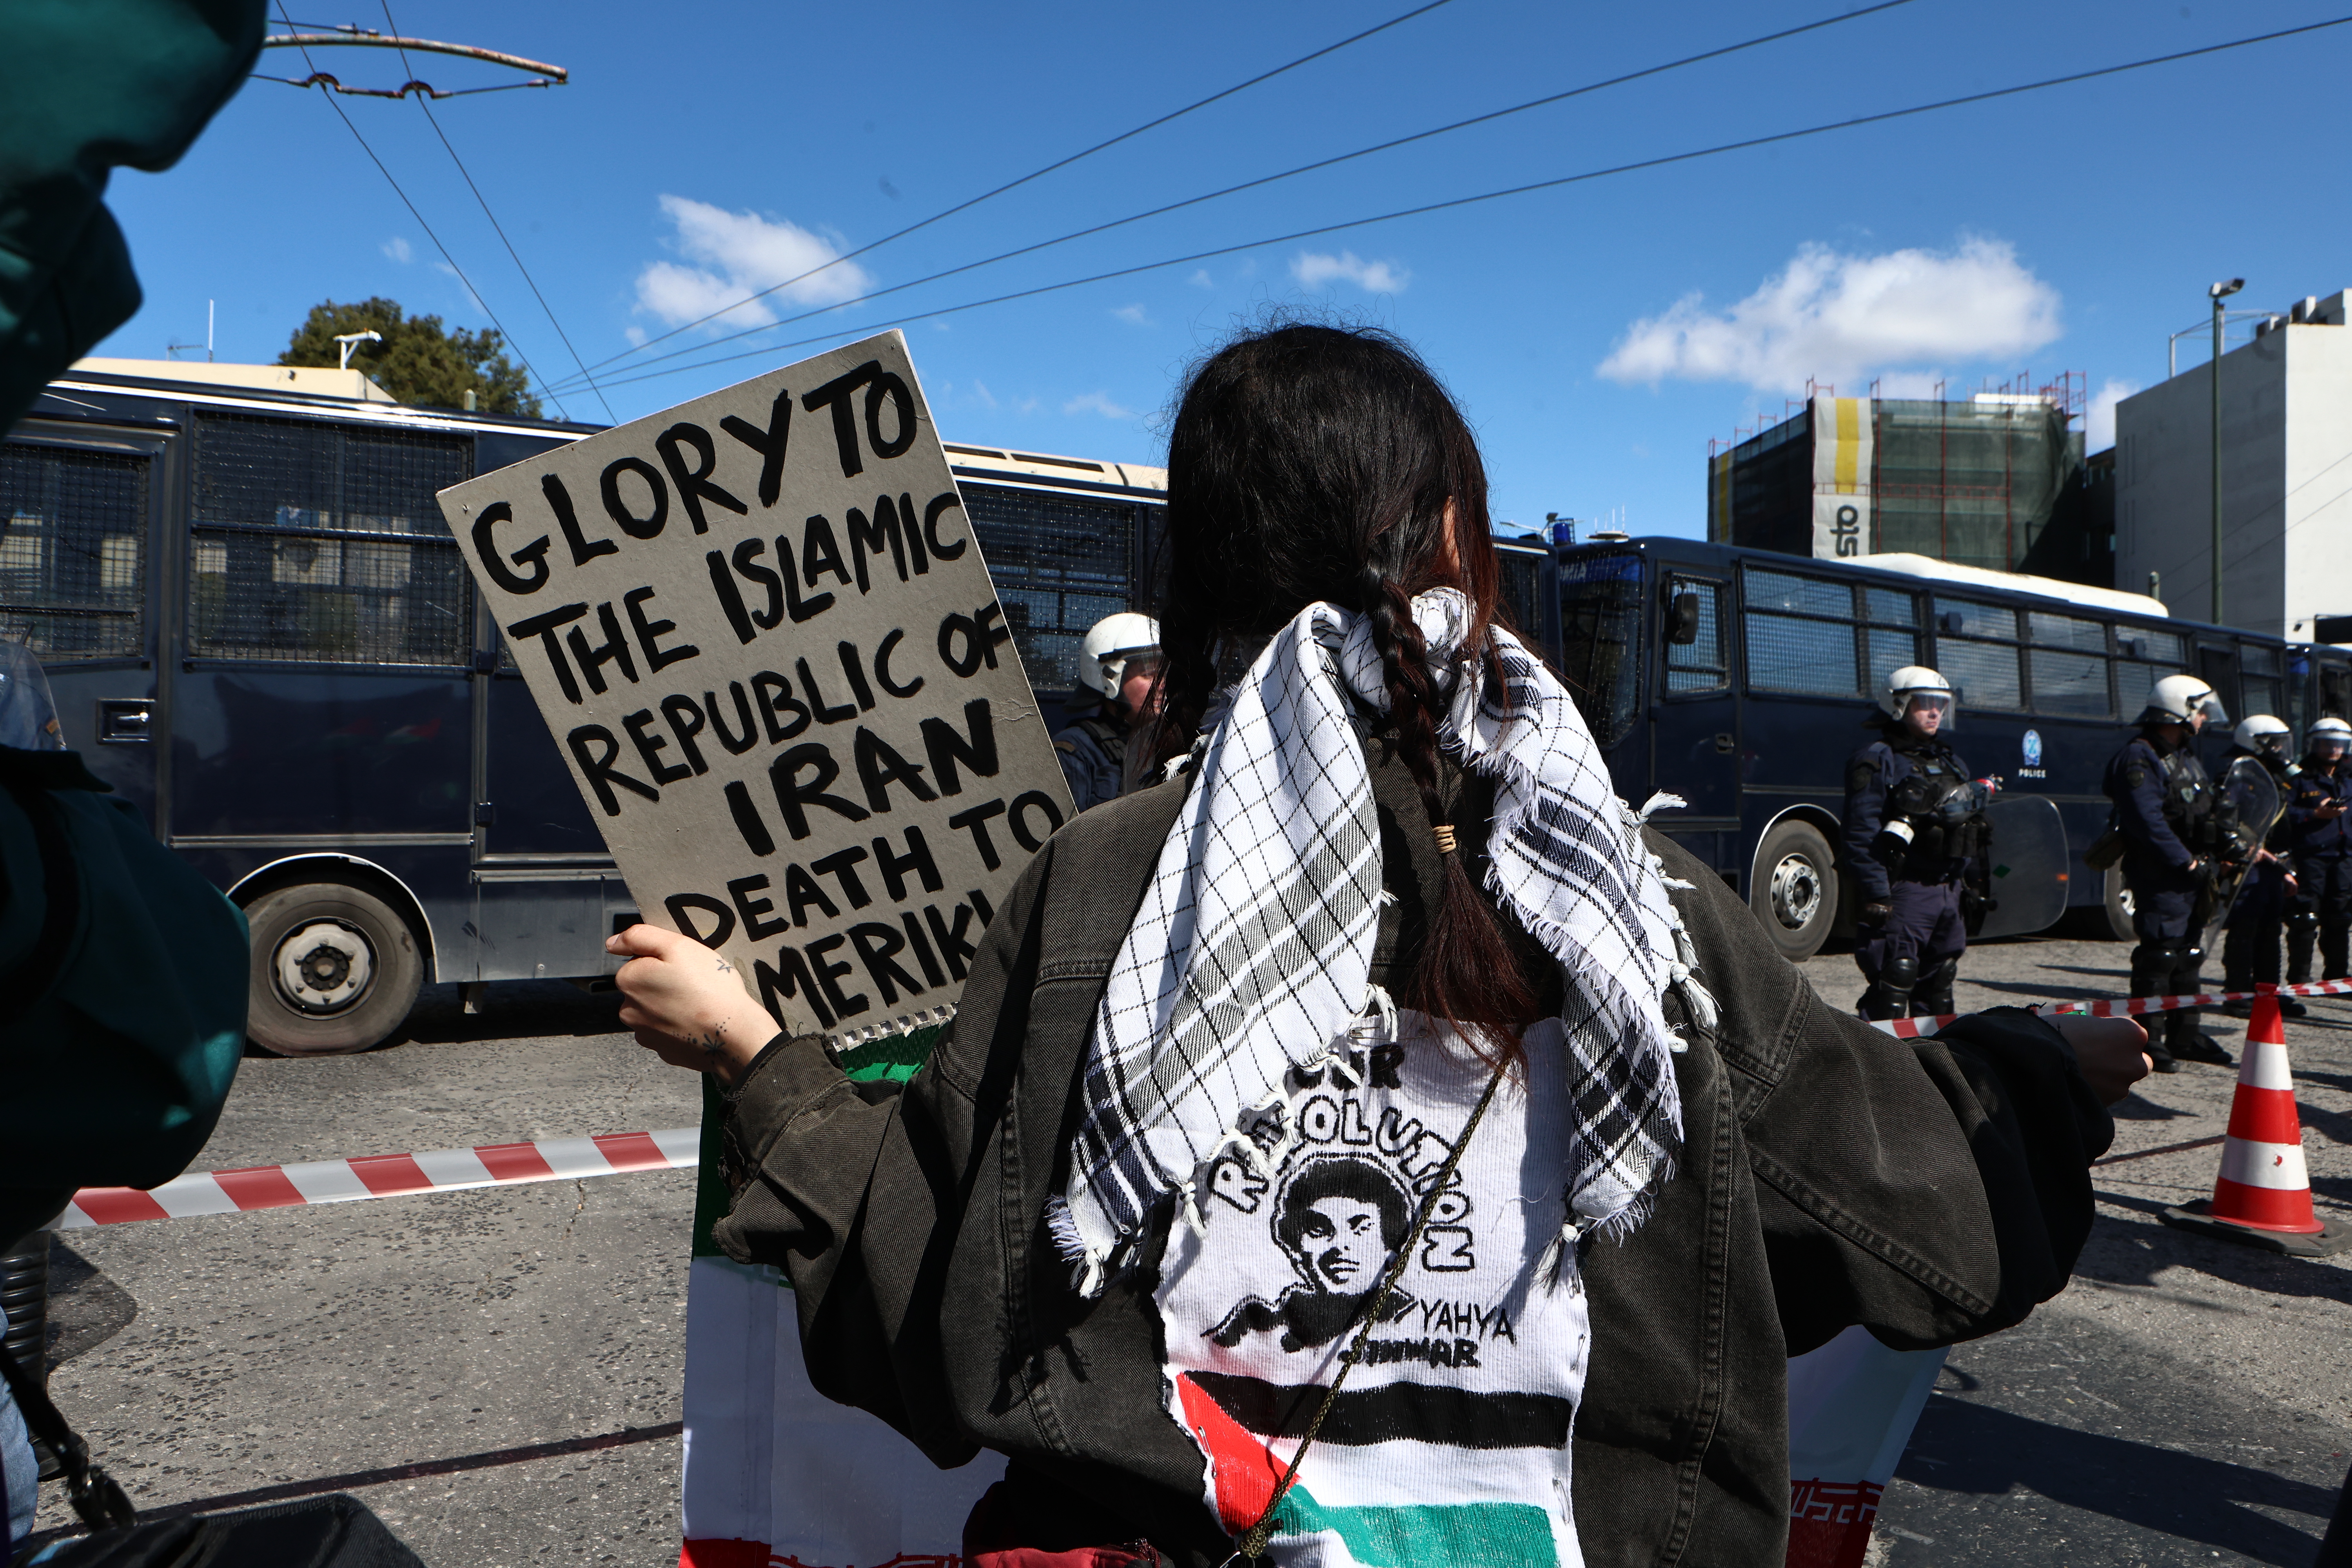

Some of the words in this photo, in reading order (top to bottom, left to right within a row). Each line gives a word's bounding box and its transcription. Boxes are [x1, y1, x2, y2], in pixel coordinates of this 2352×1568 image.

[472, 389, 792, 594] GLORY
[801, 360, 917, 478] TO
[507, 586, 699, 704] THE
[706, 492, 967, 645] ISLAMIC
[567, 628, 924, 816] REPUBLIC
[938, 599, 1011, 678] OF
[724, 698, 999, 857] IRAN
[2018, 768, 2047, 779] POLICE
[664, 825, 944, 950] DEATH
[949, 791, 1063, 873] TO
[1207, 1095, 1475, 1272] ROLUTION
[1420, 1298, 1517, 1346] YAHYA
